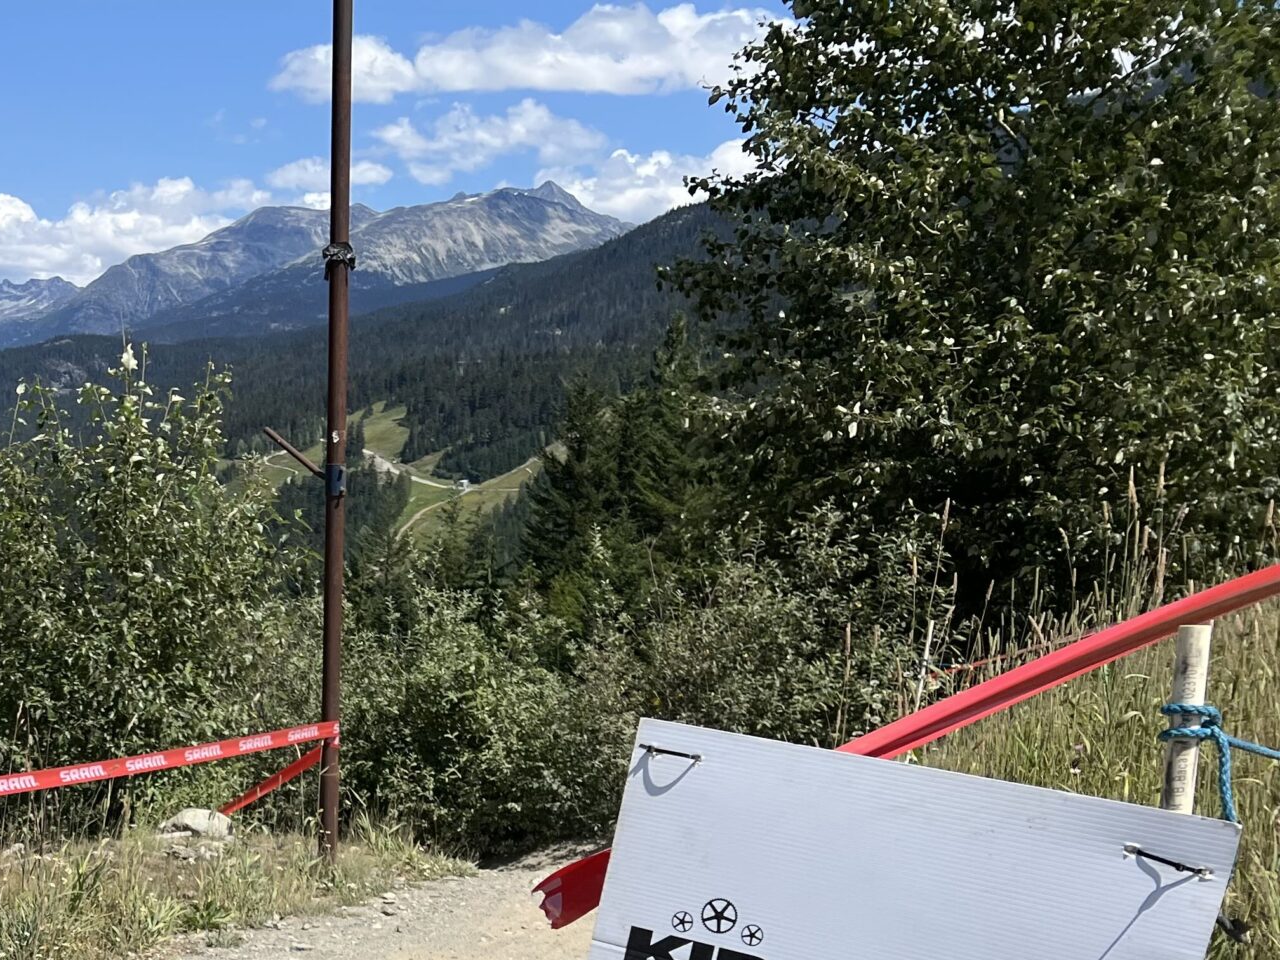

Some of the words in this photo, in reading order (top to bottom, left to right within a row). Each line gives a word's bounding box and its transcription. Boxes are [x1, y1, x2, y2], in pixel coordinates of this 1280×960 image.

[60, 764, 105, 782] SRAM
[126, 754, 166, 772] SRAM
[184, 744, 221, 761] SRAM
[239, 735, 271, 751] SRAM
[287, 726, 317, 741] SRAM
